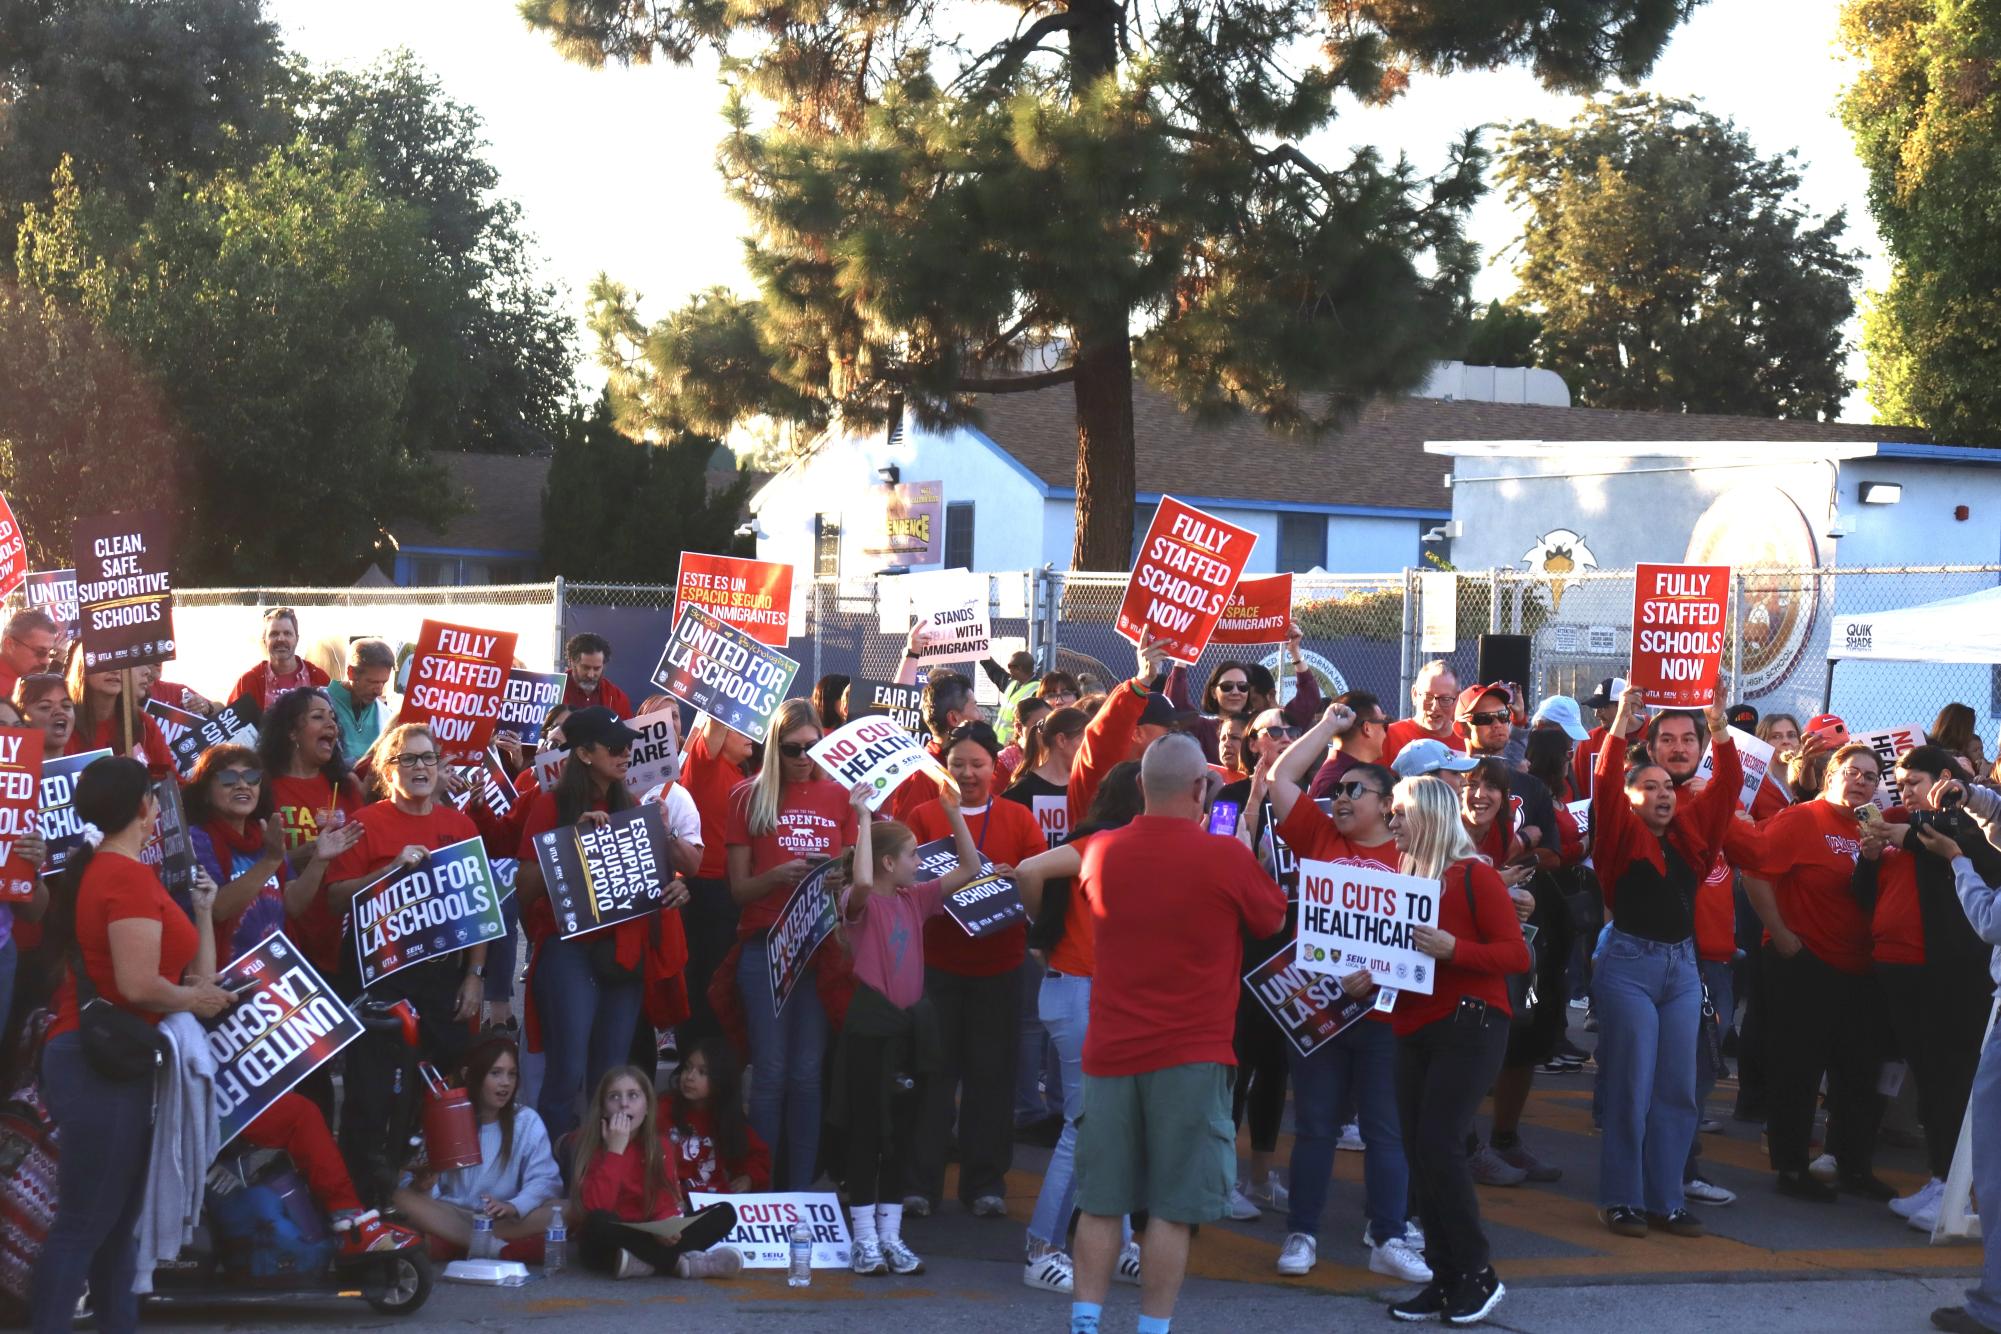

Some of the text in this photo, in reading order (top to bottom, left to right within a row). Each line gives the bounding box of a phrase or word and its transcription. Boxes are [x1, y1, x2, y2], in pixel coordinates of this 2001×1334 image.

[1171, 513, 1232, 554] FULLY
[95, 534, 147, 558] CLEAN,
[102, 556, 143, 578] SAFE,
[1150, 537, 1232, 588] STAFFED
[30, 580, 78, 604] UNITE
[79, 572, 170, 603] SUPPORTIVE
[683, 572, 746, 592] ESTE ES UN
[1138, 564, 1224, 616] SCHOOLS
[1656, 573, 1711, 596] FULLY
[681, 587, 772, 609] ESPACIO SEGURO
[1237, 594, 1245, 605] A
[92, 603, 161, 630] SCHOOLS
[713, 605, 786, 625] INMIGRANTES
[934, 608, 975, 626] STANDS
[1146, 598, 1196, 633] NOW
[1218, 616, 1284, 630] IMMIGRANTS
[1226, 606, 1260, 618] SPACE
[1642, 602, 1720, 625] STAFFED
[956, 624, 983, 639] WITH
[1846, 624, 1872, 636] QUIK
[437, 629, 498, 657] FULLY
[920, 639, 989, 658] IMMIGRANTS
[1640, 631, 1722, 654] SCHOOLS
[1846, 637, 1872, 648] SHADE
[98, 650, 113, 661] UTLA
[679, 617, 787, 694] UNITED FOR
[419, 656, 502, 689] STAFFED
[668, 641, 776, 716] LA SCHOOLS
[1660, 658, 1704, 681] NOW
[504, 679, 561, 705] TED FOR
[673, 680, 687, 694] UTLA
[875, 686, 907, 708] FAIR
[411, 685, 499, 718] SCHOOLS
[499, 701, 548, 725] CHOOL
[429, 715, 475, 742] NOW
[640, 721, 667, 740] TO
[889, 709, 920, 729] FAIR
[822, 739, 857, 768] NO
[856, 722, 900, 745] CUT
[840, 735, 916, 785] HEALTH
[902, 754, 922, 765] SEIU
[36, 807, 84, 840] SCHO
[777, 814, 836, 827] RPENTER
[1039, 808, 1065, 830] NO
[778, 836, 830, 848] COUGARS
[549, 846, 559, 863] UTLA
[630, 817, 661, 900] ESCUELAS
[580, 833, 613, 912] DE APOYO
[596, 823, 633, 911] SEGURAS Y
[359, 871, 432, 929] UNITED
[432, 855, 484, 894] FOR
[953, 878, 1013, 907] SCHOOLS
[1305, 875, 1432, 923] NO CUTS TO
[362, 885, 491, 957] LA SCHOOLS
[770, 893, 806, 965] UNITED
[1304, 905, 1418, 952] HEALTHCAR
[773, 892, 830, 989] LA SCHOOLS
[382, 954, 398, 968] UTLA
[406, 943, 423, 954] SEIU
[1346, 953, 1391, 973] SEIU UTLA
[241, 959, 265, 977] UTLA
[208, 966, 319, 1064] LA SCHO
[1278, 995, 1316, 1030] LA
[1318, 1020, 1335, 1034] UTLA
[238, 997, 344, 1087] UNITED
[739, 1203, 837, 1224] CUTS TO
